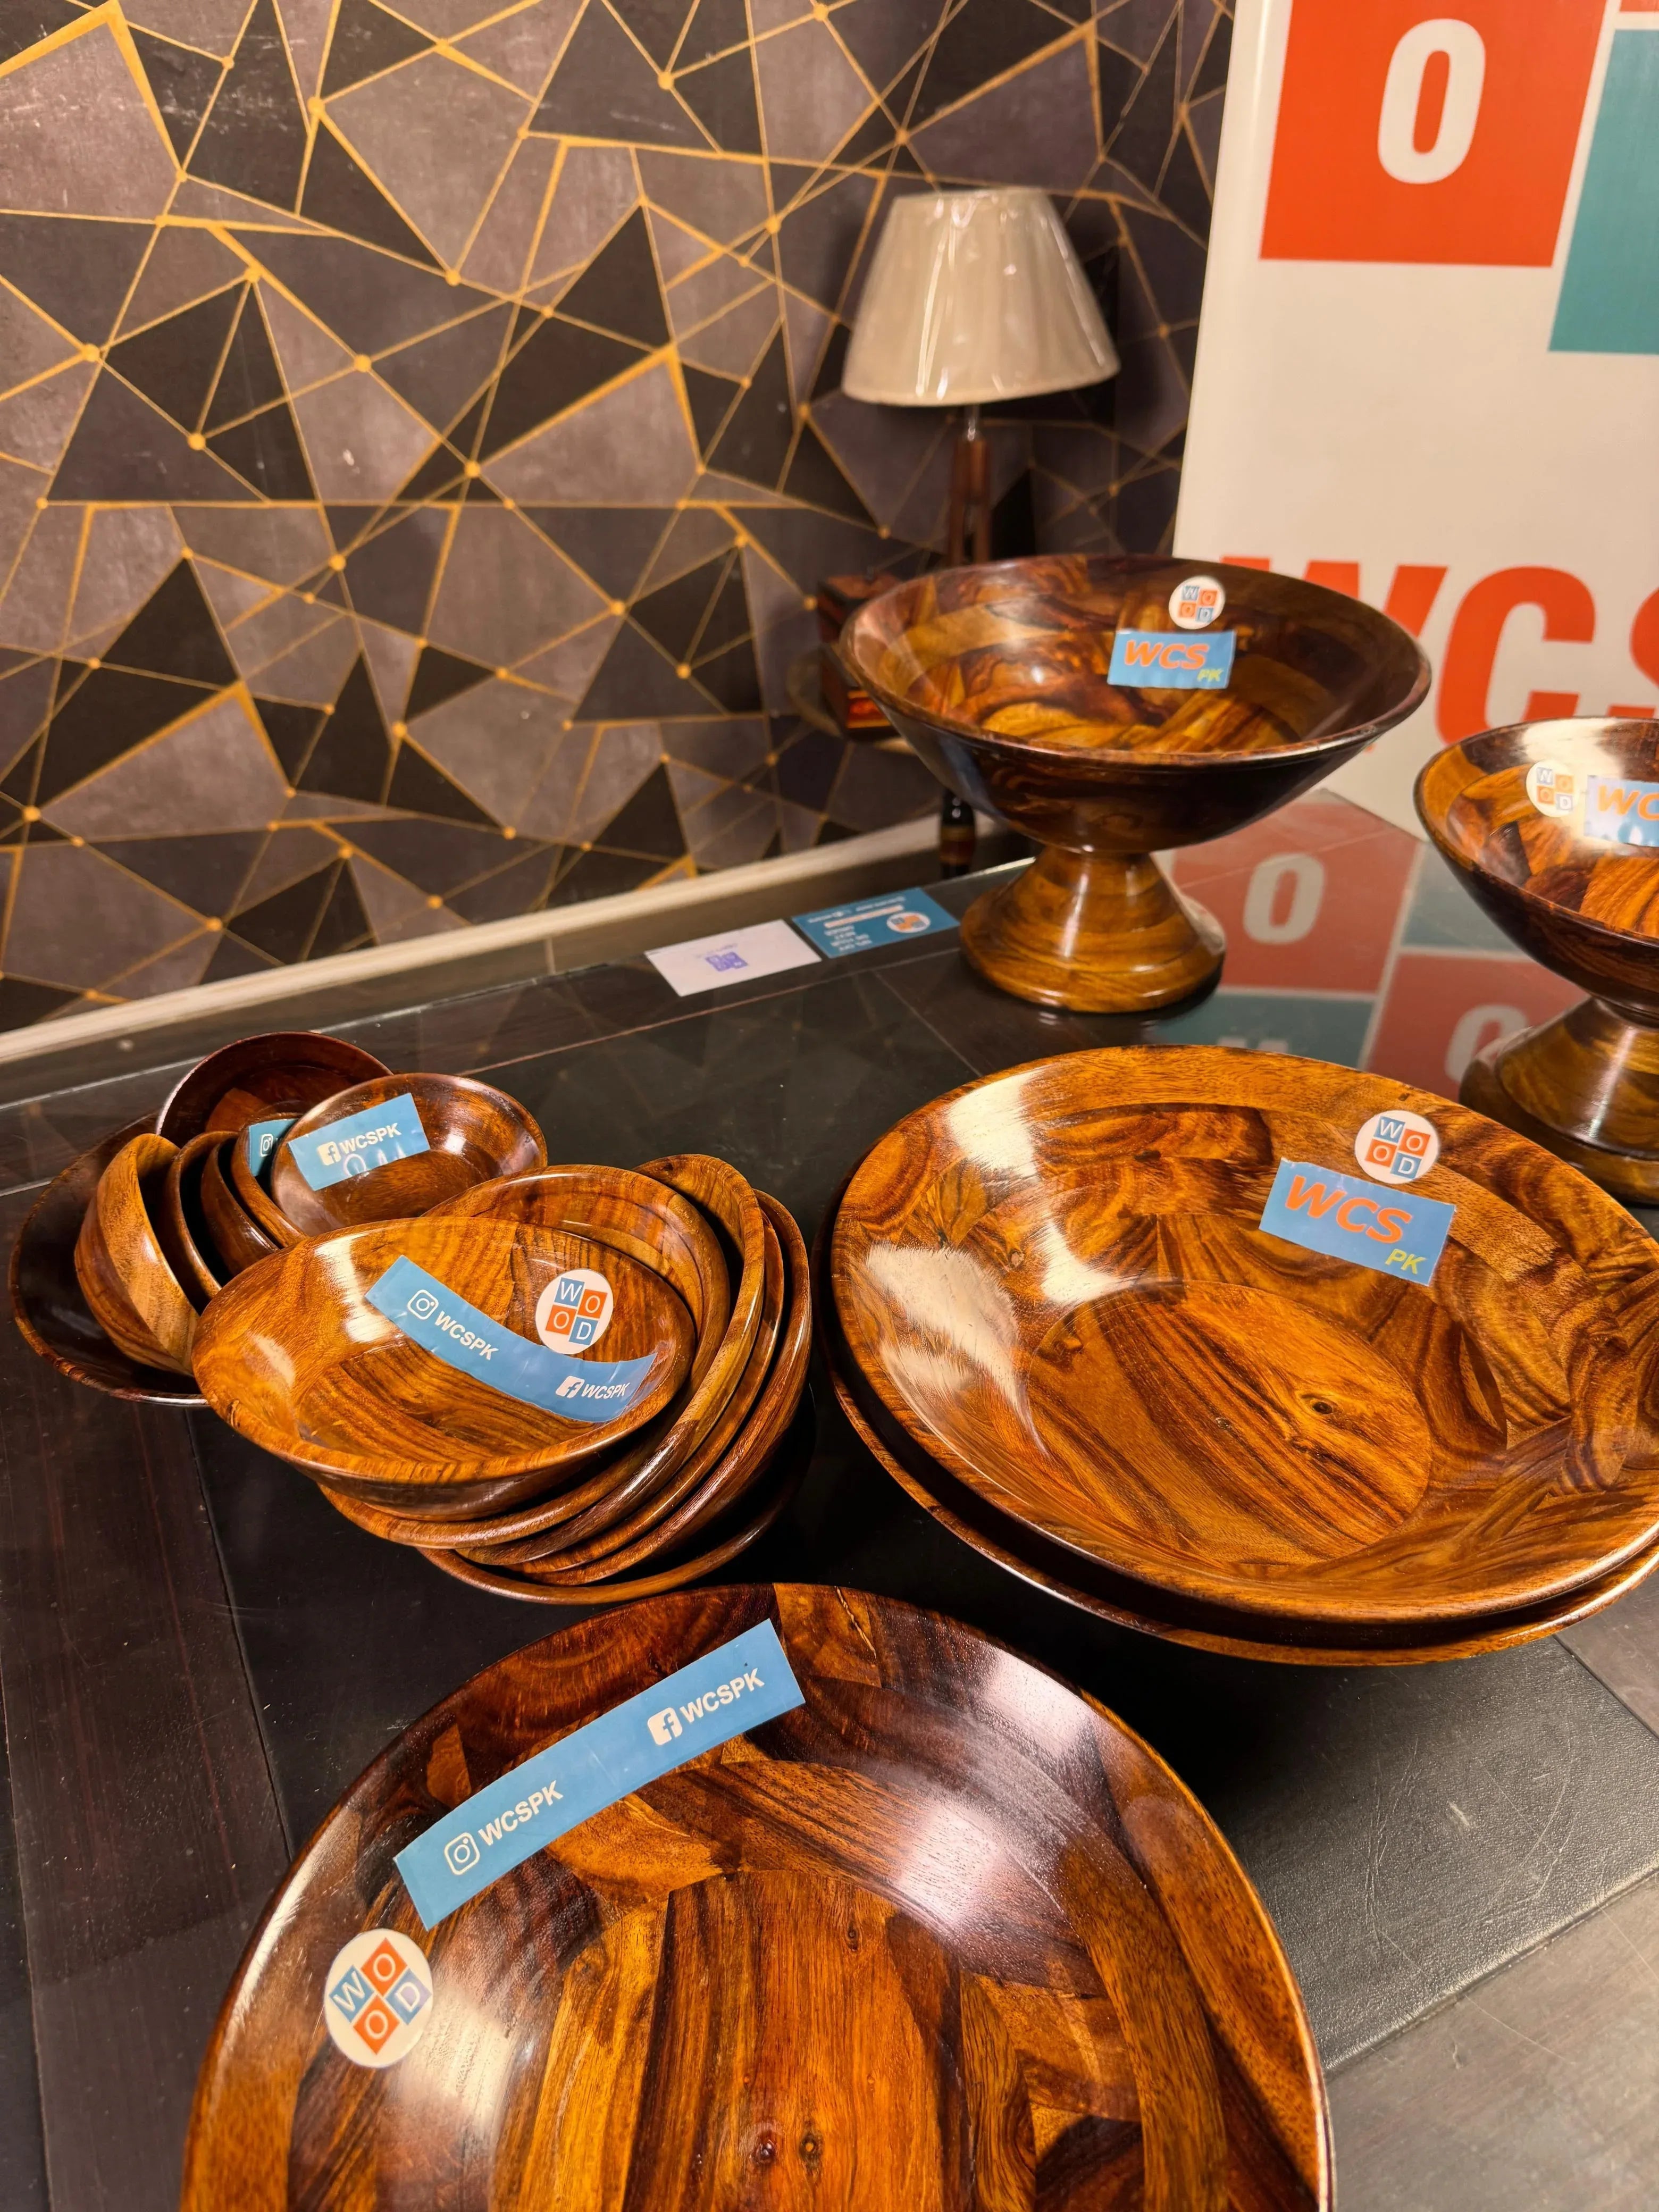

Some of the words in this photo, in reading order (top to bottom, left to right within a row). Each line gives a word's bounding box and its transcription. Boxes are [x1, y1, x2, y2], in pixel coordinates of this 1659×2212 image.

[1124, 640, 1210, 670] WCS
[1197, 668, 1224, 682] PK
[339, 1122, 401, 1154] WCSPK
[1285, 1175, 1413, 1244] WCS
[1385, 1249, 1427, 1275] PK
[434, 1310, 499, 1361] WCSPK
[581, 1382, 630, 1400] WCSPK
[479, 1780, 564, 1847] WCSPK
[679, 1668, 765, 1725] WCSPK
